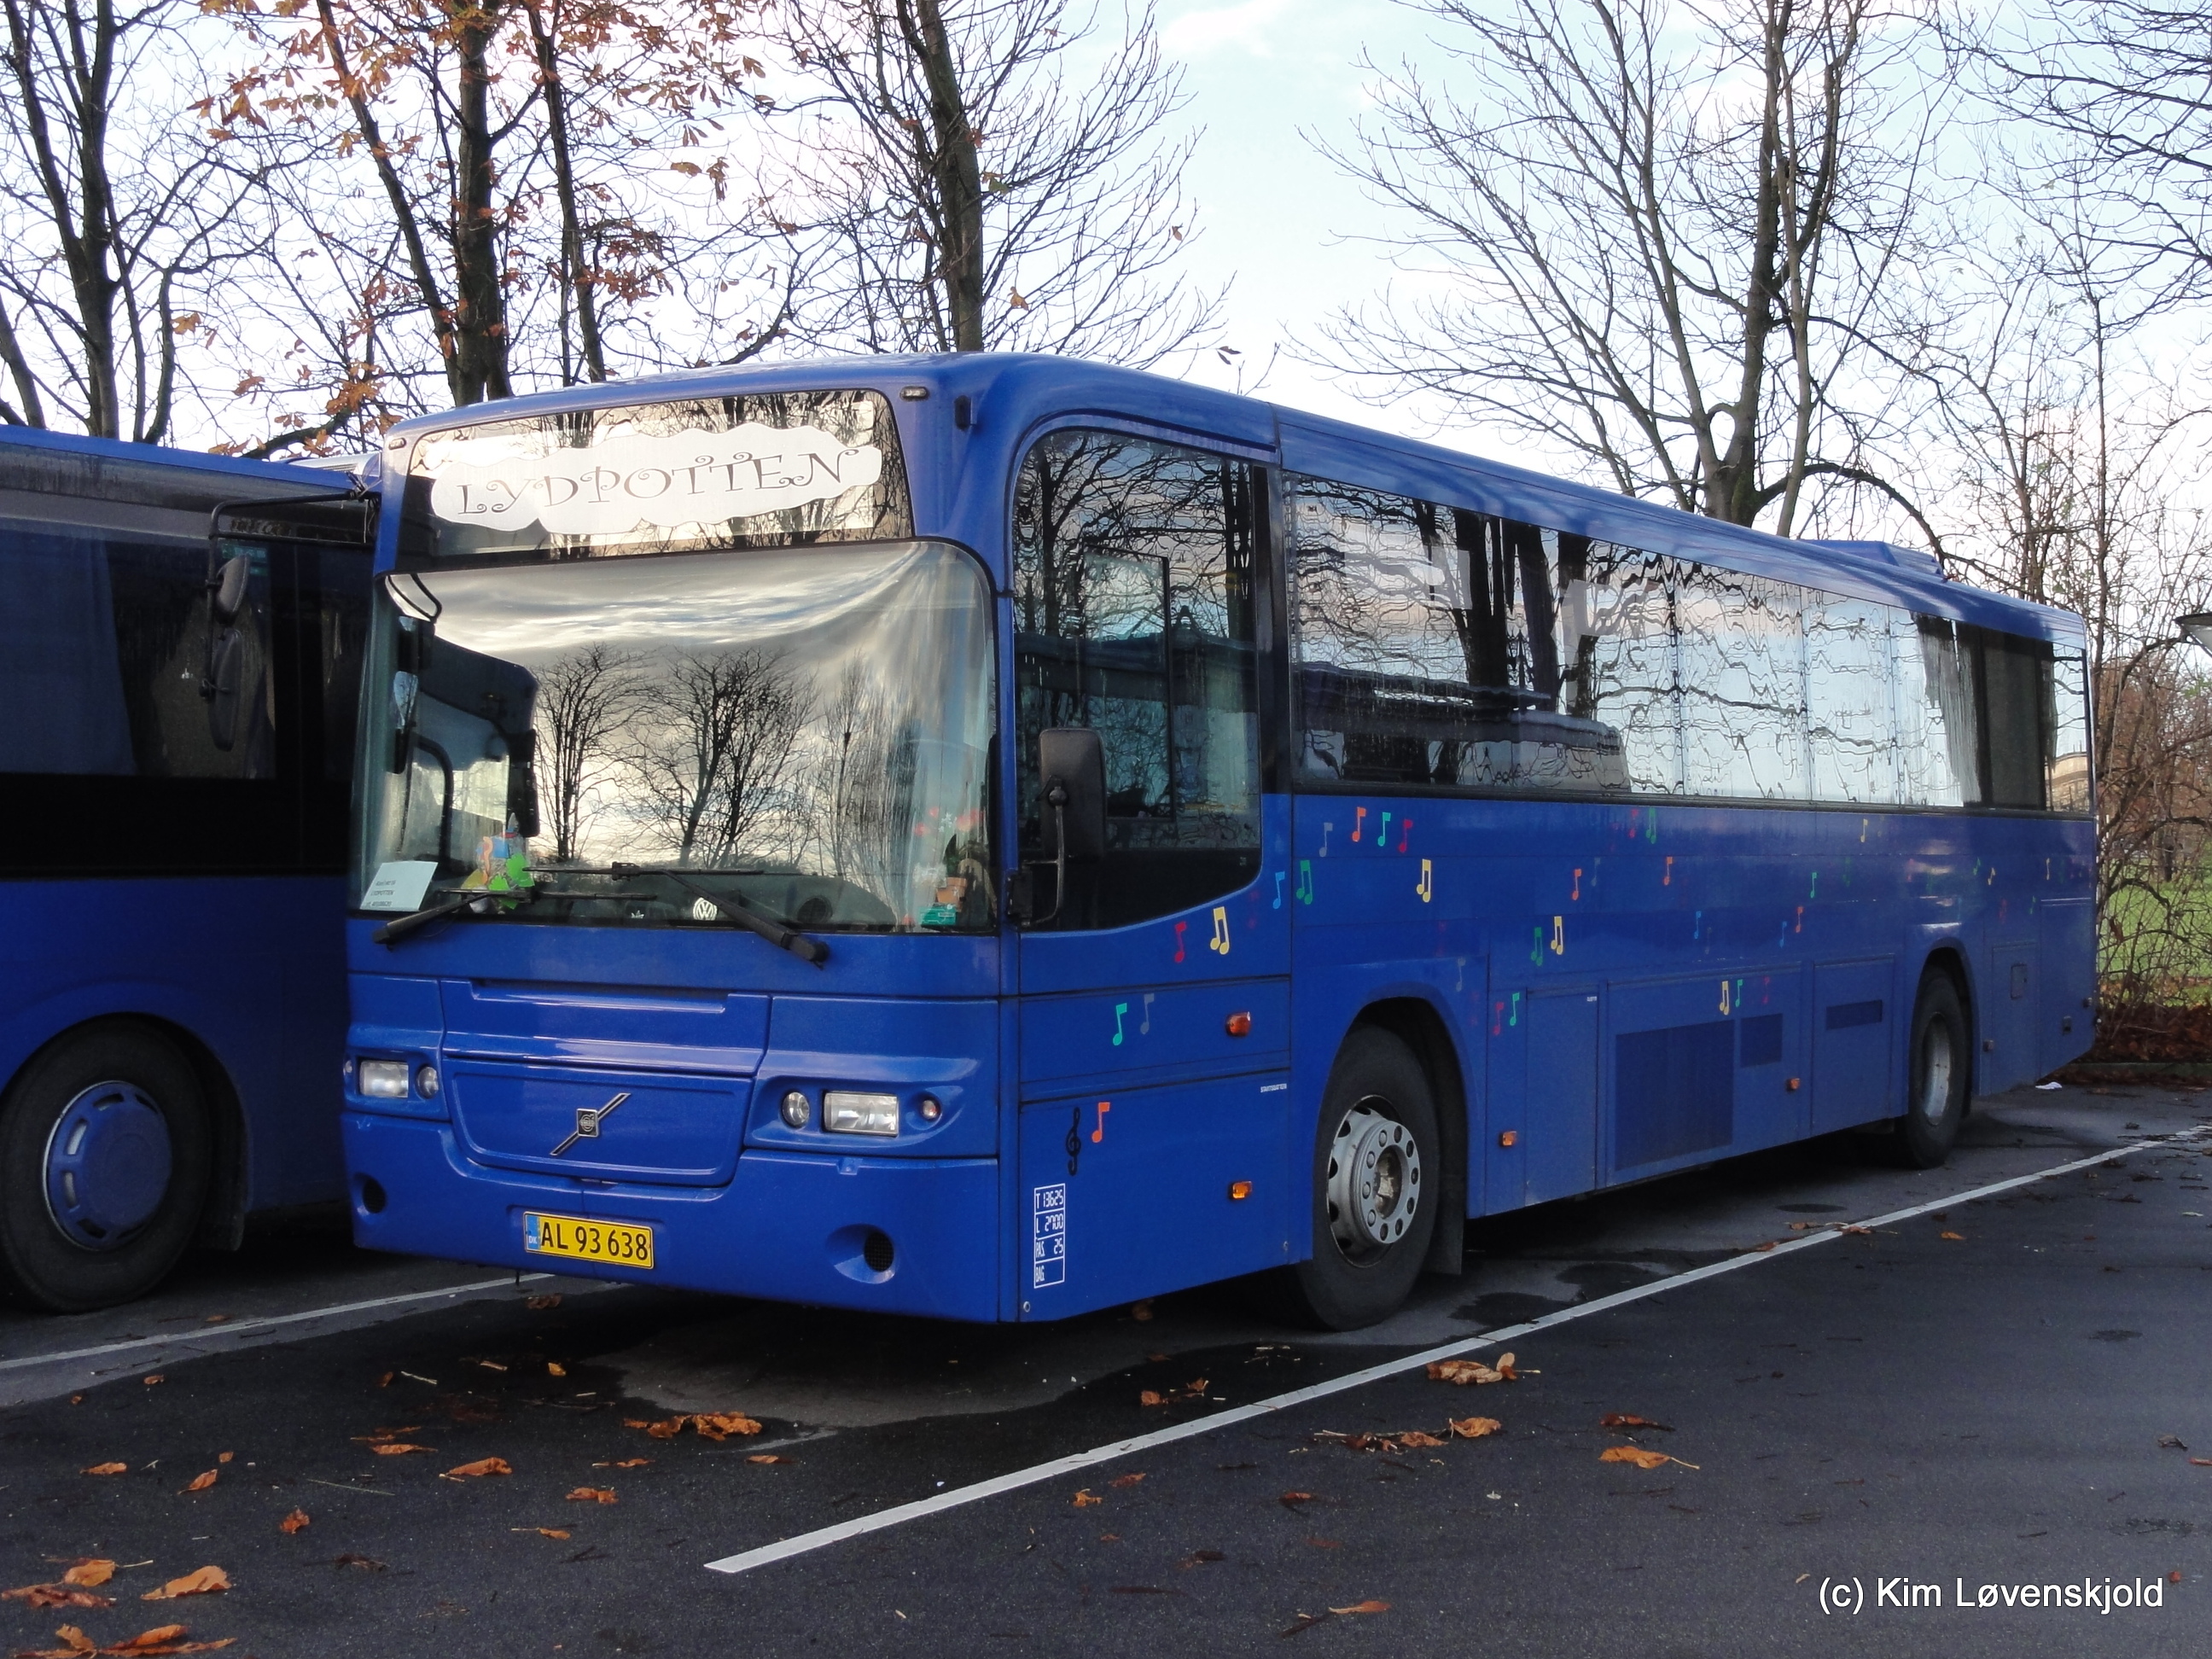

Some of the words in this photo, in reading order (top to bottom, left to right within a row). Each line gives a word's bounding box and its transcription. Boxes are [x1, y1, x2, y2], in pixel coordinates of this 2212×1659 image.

[457, 449, 860, 515] LYDPOTTEN
[1036, 1193, 1040, 1208] T
[1043, 1190, 1063, 1208] 13625
[1036, 1218, 1040, 1233] L
[1045, 1214, 1063, 1231] 2700
[528, 1235, 538, 1244] DK
[540, 1221, 569, 1250] AL
[575, 1225, 602, 1254] 93
[608, 1229, 649, 1261] 638
[1053, 1237, 1063, 1254] 25
